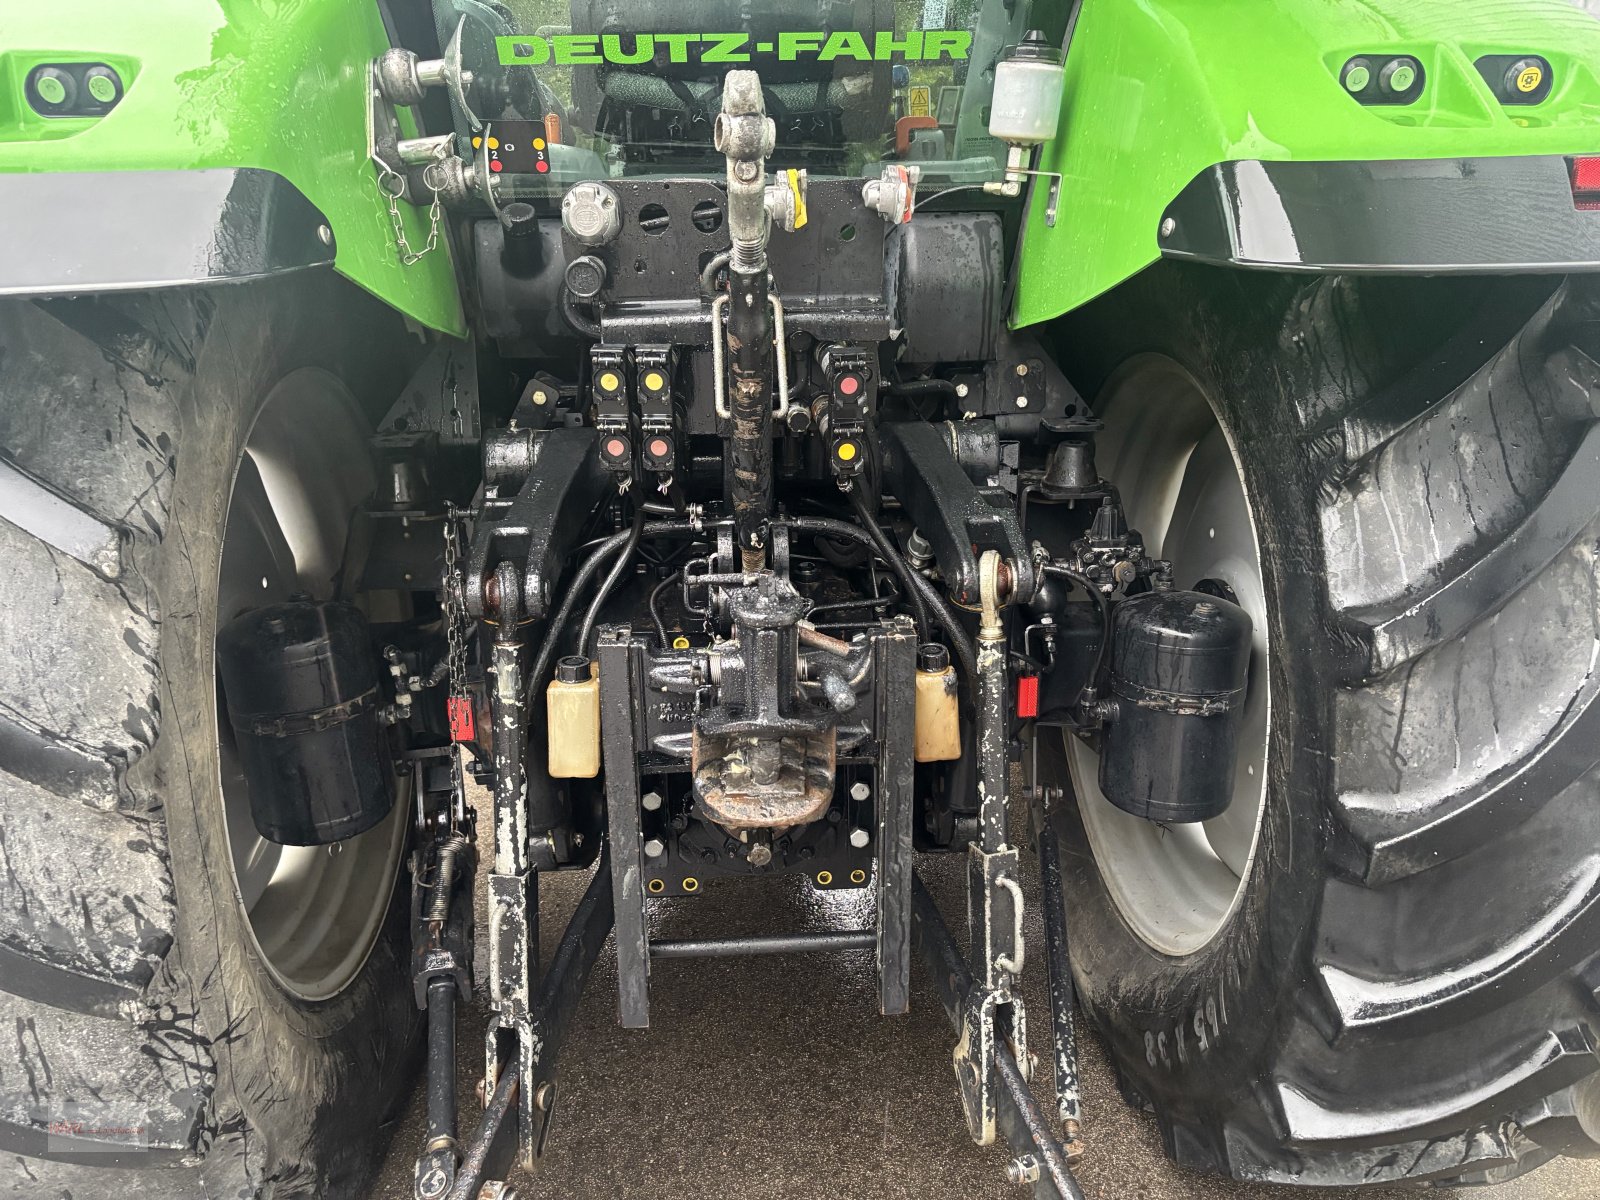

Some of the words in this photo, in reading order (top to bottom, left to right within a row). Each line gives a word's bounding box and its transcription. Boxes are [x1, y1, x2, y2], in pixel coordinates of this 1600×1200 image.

[495, 31, 972, 65] DEUTZ-FAHR
[491, 151, 498, 159] 2
[537, 151, 544, 160] 3
